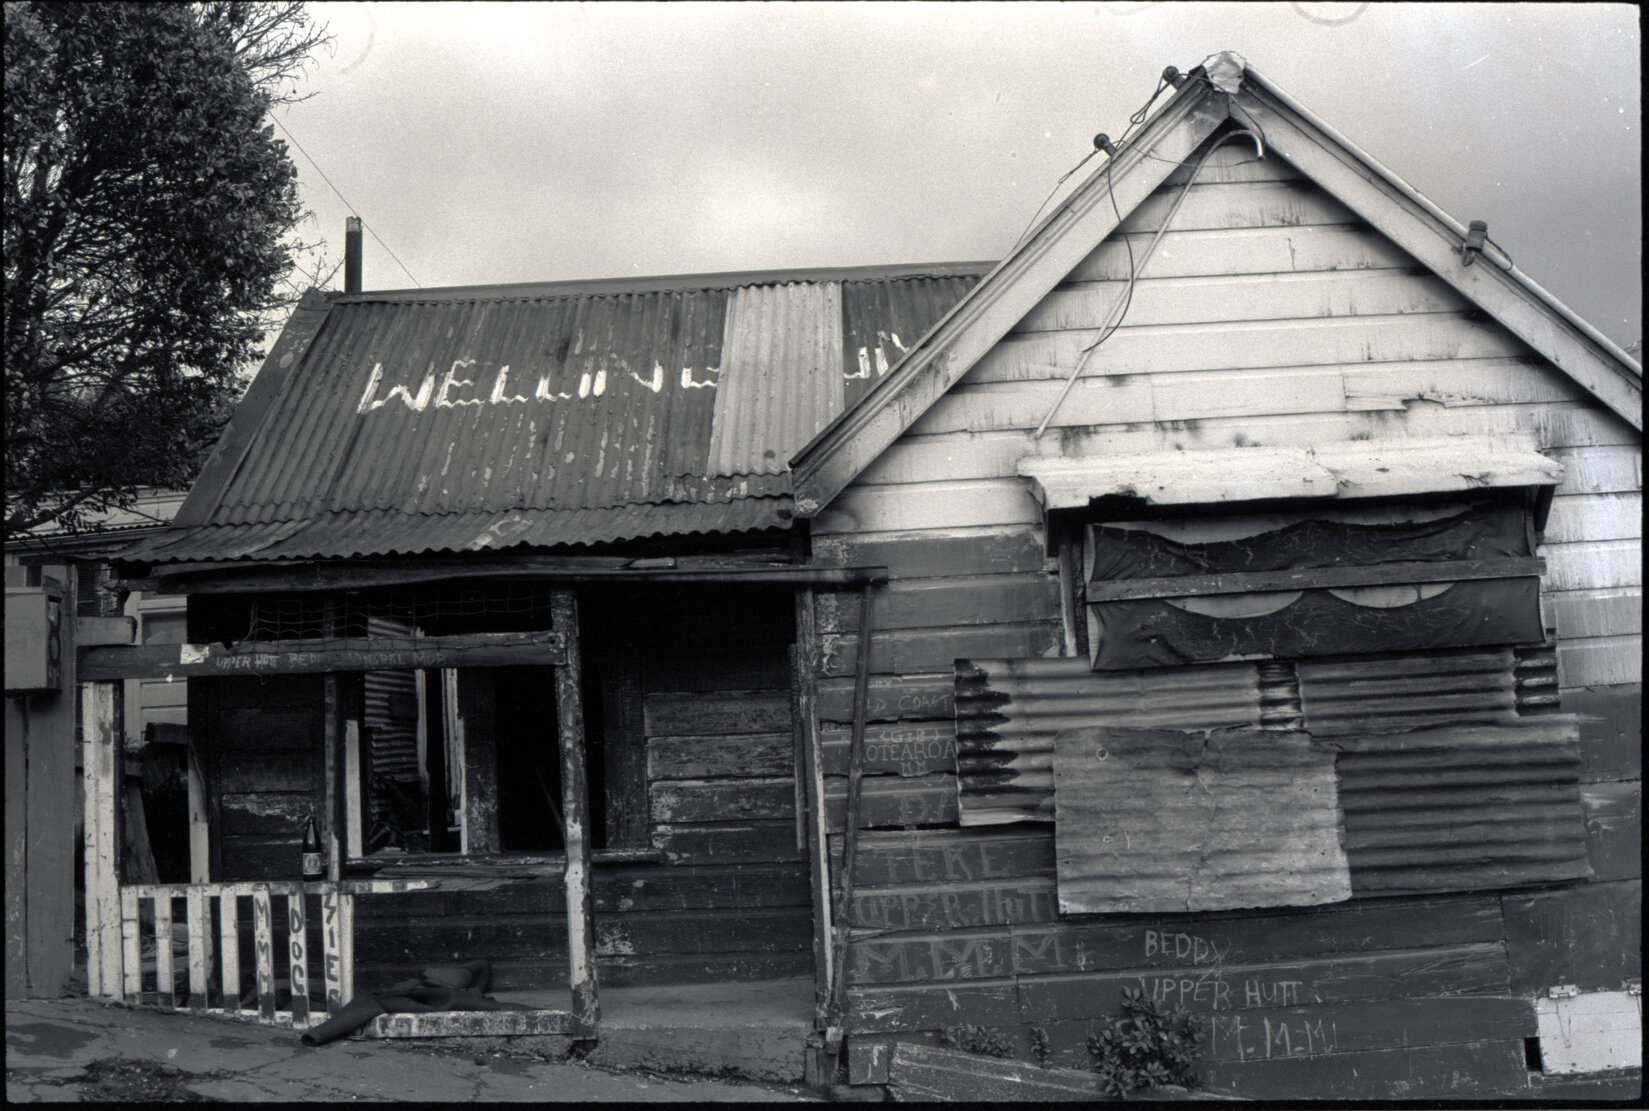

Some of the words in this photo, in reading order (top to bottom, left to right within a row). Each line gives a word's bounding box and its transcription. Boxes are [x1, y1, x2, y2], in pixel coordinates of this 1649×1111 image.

[862, 739, 958, 762] OTEAROA
[1145, 930, 1231, 978] BEDDY
[1245, 977, 1303, 1009] HUTT
